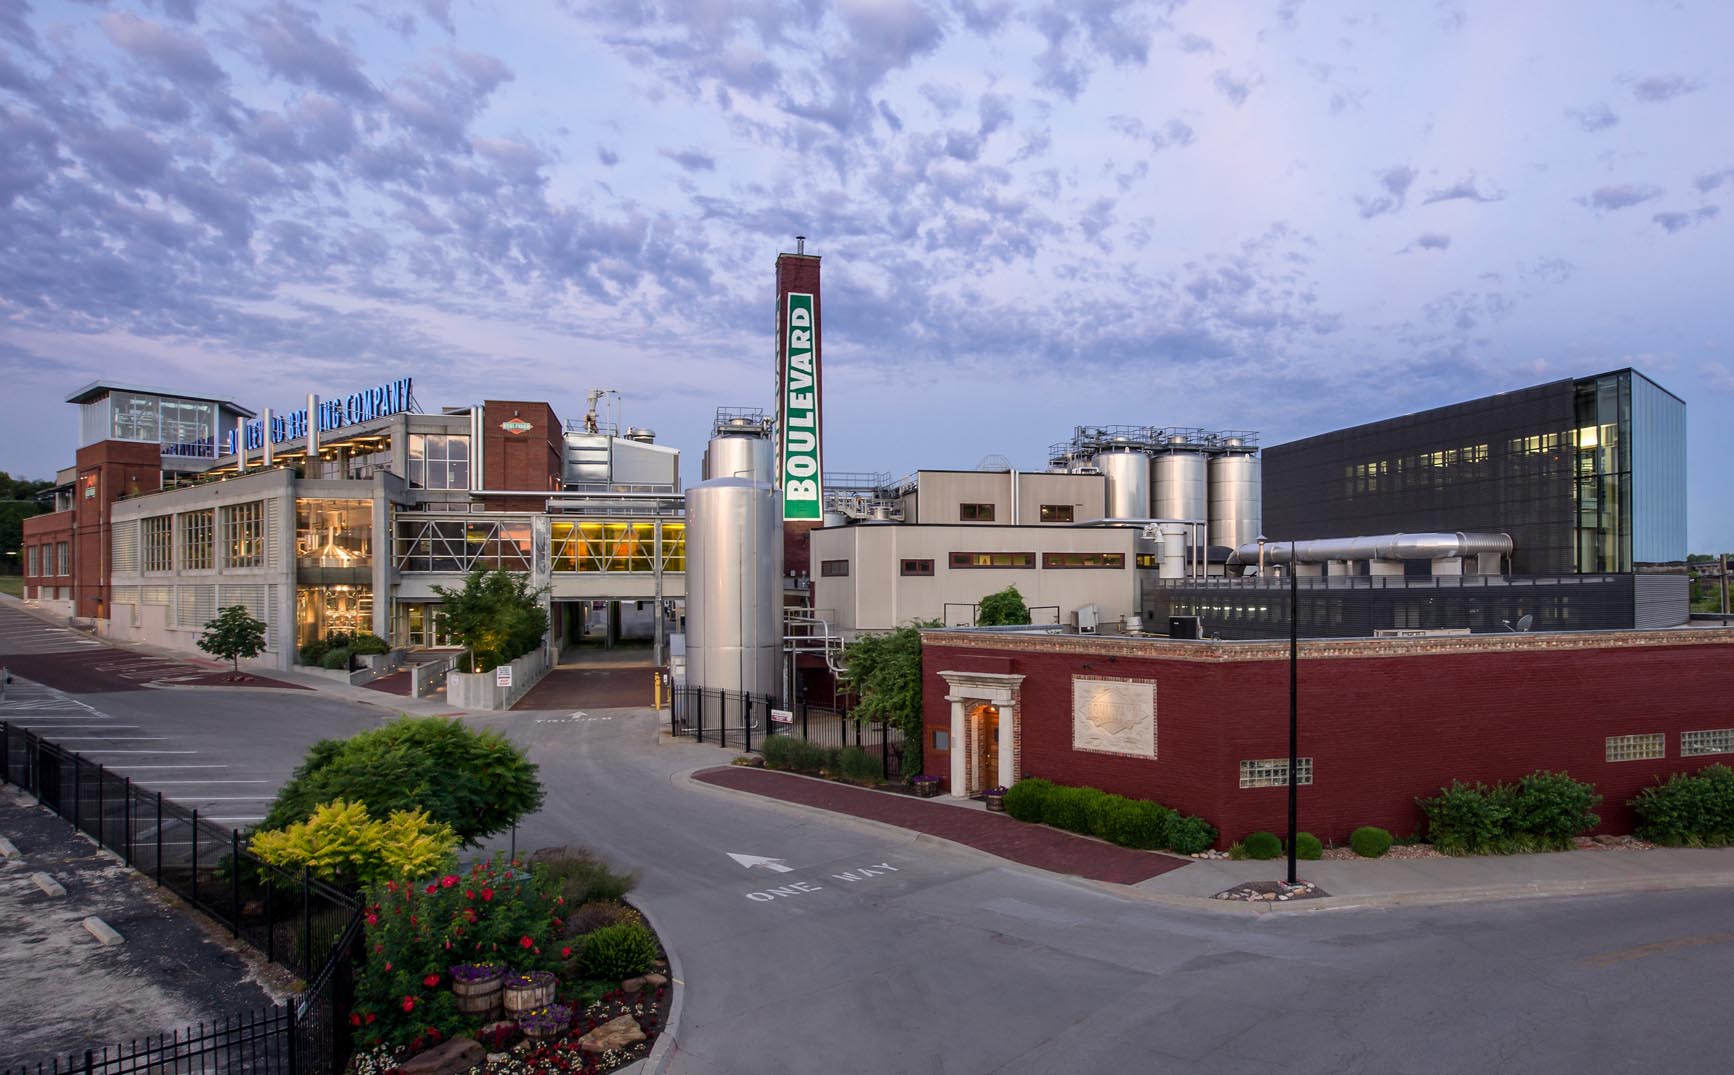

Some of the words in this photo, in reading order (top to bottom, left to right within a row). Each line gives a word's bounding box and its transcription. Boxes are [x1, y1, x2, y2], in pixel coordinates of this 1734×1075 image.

[288, 398, 342, 440] BREING
[345, 377, 412, 426] COMPANY
[786, 306, 818, 501] BOULEVARD
[745, 881, 823, 902] ONE
[831, 862, 899, 882] WAY
